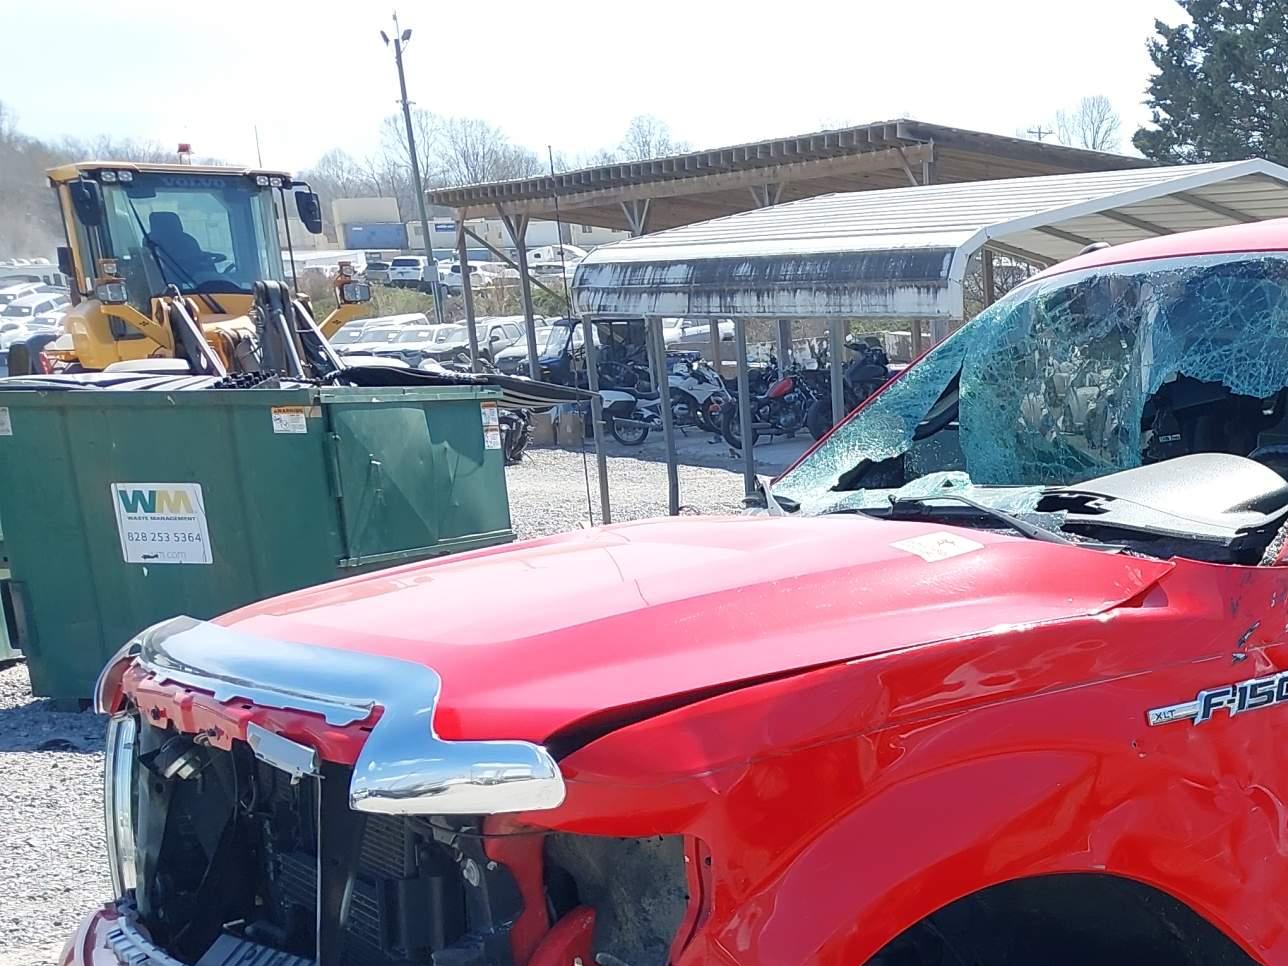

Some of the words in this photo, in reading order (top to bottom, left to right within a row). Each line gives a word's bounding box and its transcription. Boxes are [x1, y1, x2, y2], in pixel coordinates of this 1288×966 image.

[162, 177, 226, 188] VOLVO
[118, 489, 194, 513] WM
[127, 532, 148, 542] 828
[150, 532, 170, 542] 253
[173, 532, 202, 543] 5364
[1155, 709, 1175, 721] XLT
